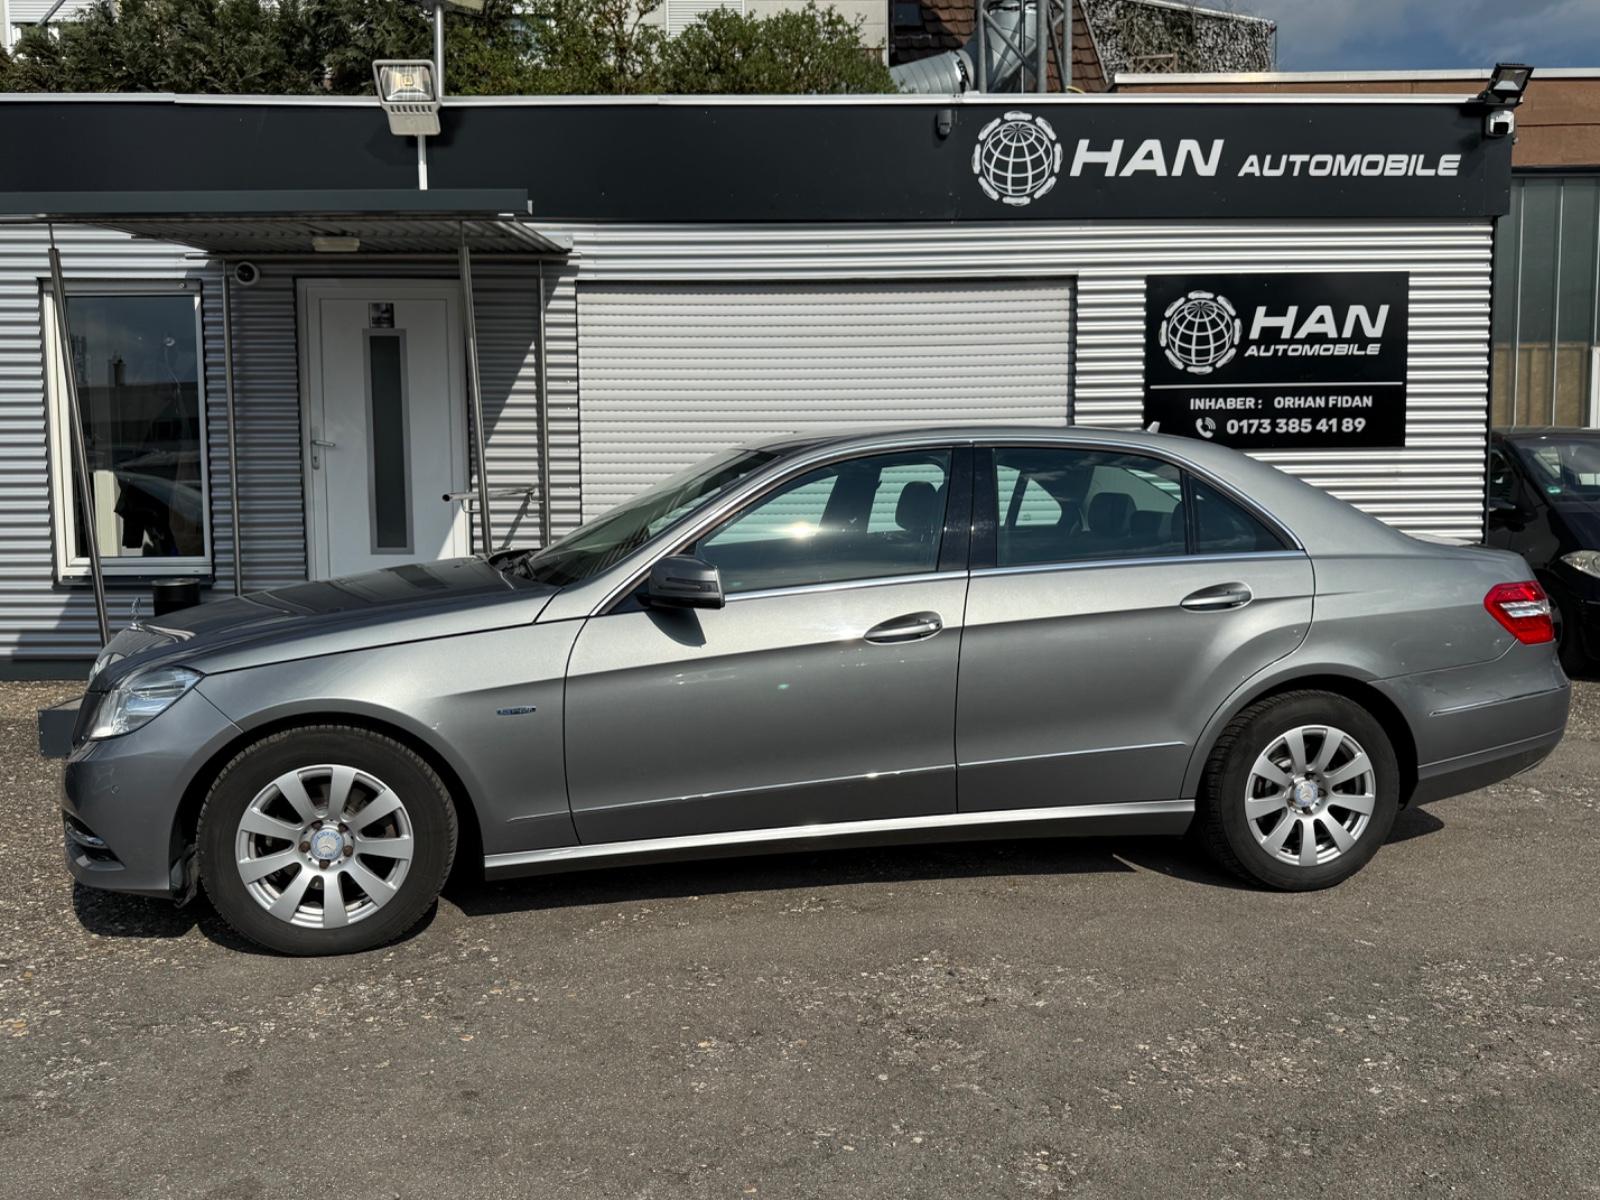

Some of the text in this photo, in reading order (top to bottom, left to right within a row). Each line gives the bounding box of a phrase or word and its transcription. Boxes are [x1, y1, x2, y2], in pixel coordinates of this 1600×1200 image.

[1069, 138, 1462, 178] HAN AUTOMOBILE
[1248, 304, 1390, 340] HAN
[1244, 343, 1381, 357] AUTOMOBILE
[1273, 396, 1326, 409] ORHAN
[1328, 395, 1373, 408] FIDAN
[1226, 417, 1366, 434] 0173 385 41 89
